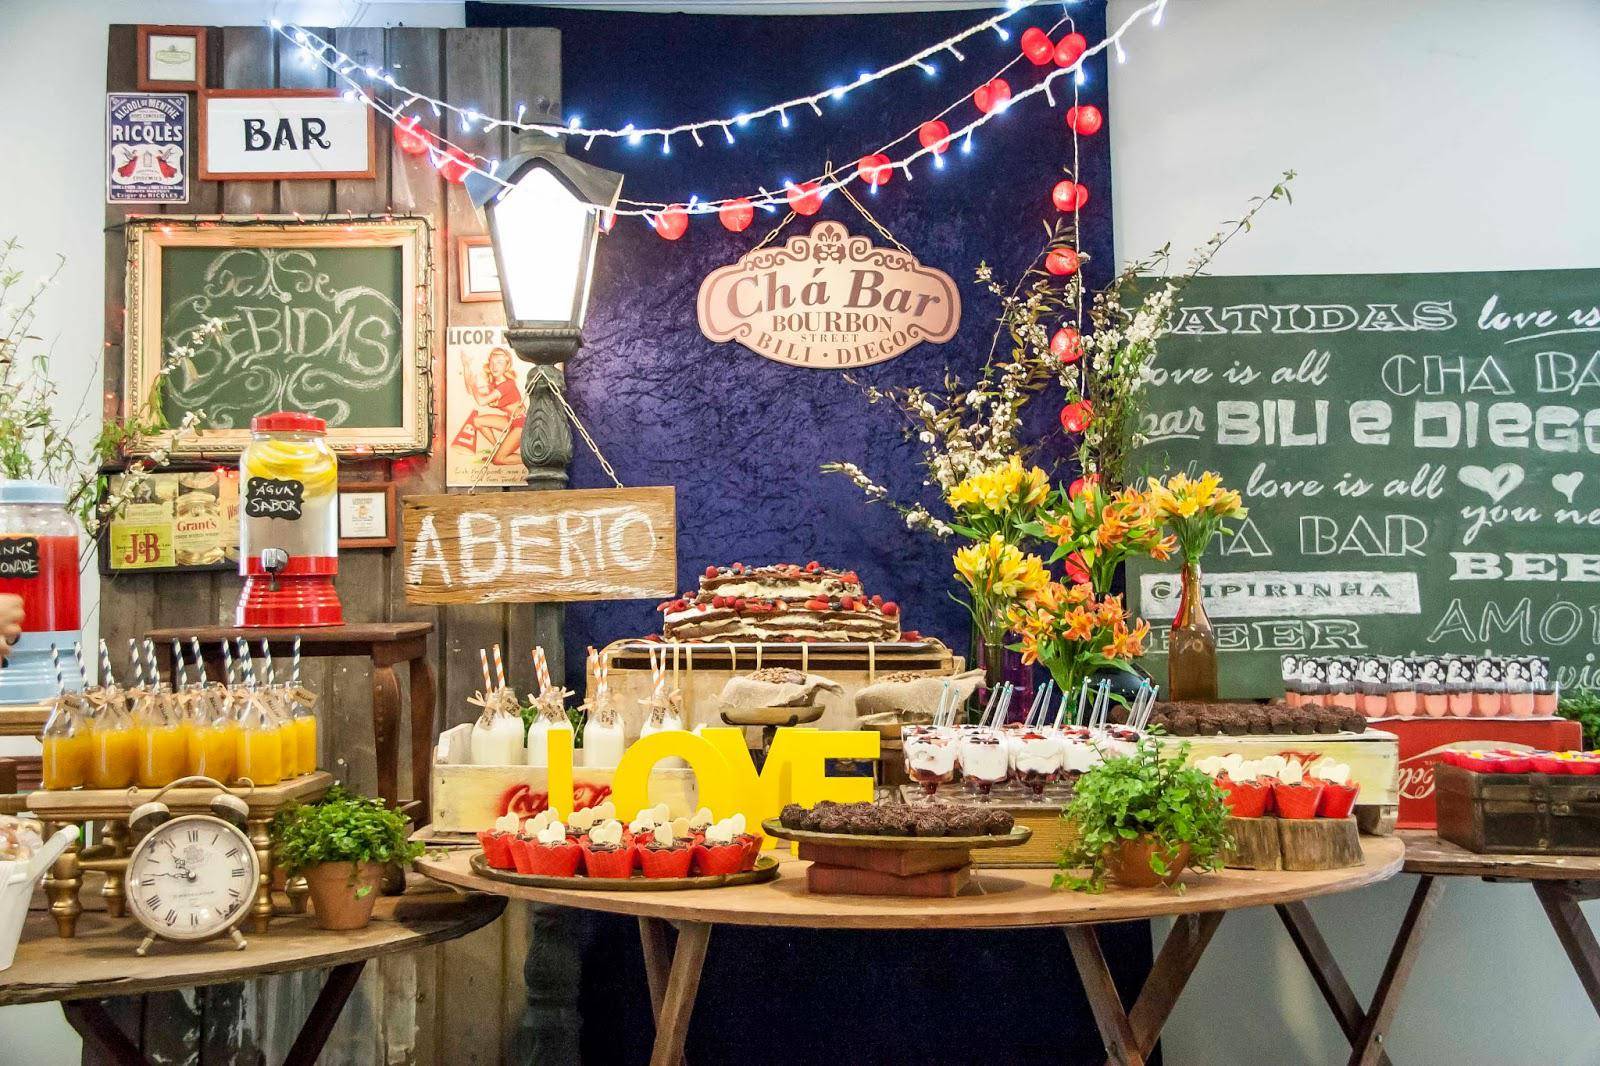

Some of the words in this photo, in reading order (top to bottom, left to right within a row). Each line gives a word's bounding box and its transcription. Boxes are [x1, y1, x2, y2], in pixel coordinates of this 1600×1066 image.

[148, 98, 180, 120] MENTHE
[243, 117, 331, 151] BAR
[727, 267, 831, 319] Chá
[843, 269, 941, 318] Bar
[772, 311, 895, 333] BOURBON
[1477, 293, 1558, 331] love
[449, 329, 494, 345] LICOR
[756, 332, 811, 363] BILI
[836, 330, 908, 365] DIEGO
[800, 333, 860, 343] STREET
[1222, 360, 1262, 386] is
[1271, 349, 1331, 386] all
[1381, 353, 1516, 396] CHA
[1216, 399, 1330, 447] BILI
[1246, 462, 1325, 498] love
[1333, 472, 1374, 498] is
[1383, 462, 1447, 499] all
[250, 497, 301, 515] SABOR
[177, 519, 217, 532] Grant's
[1299, 514, 1428, 557] BAR
[1460, 504, 1542, 546] you
[125, 533, 160, 564] J&B
[406, 504, 658, 588] ABERTO
[1150, 580, 1392, 601] CIPIRINHA
[1426, 597, 1600, 646] AMO
